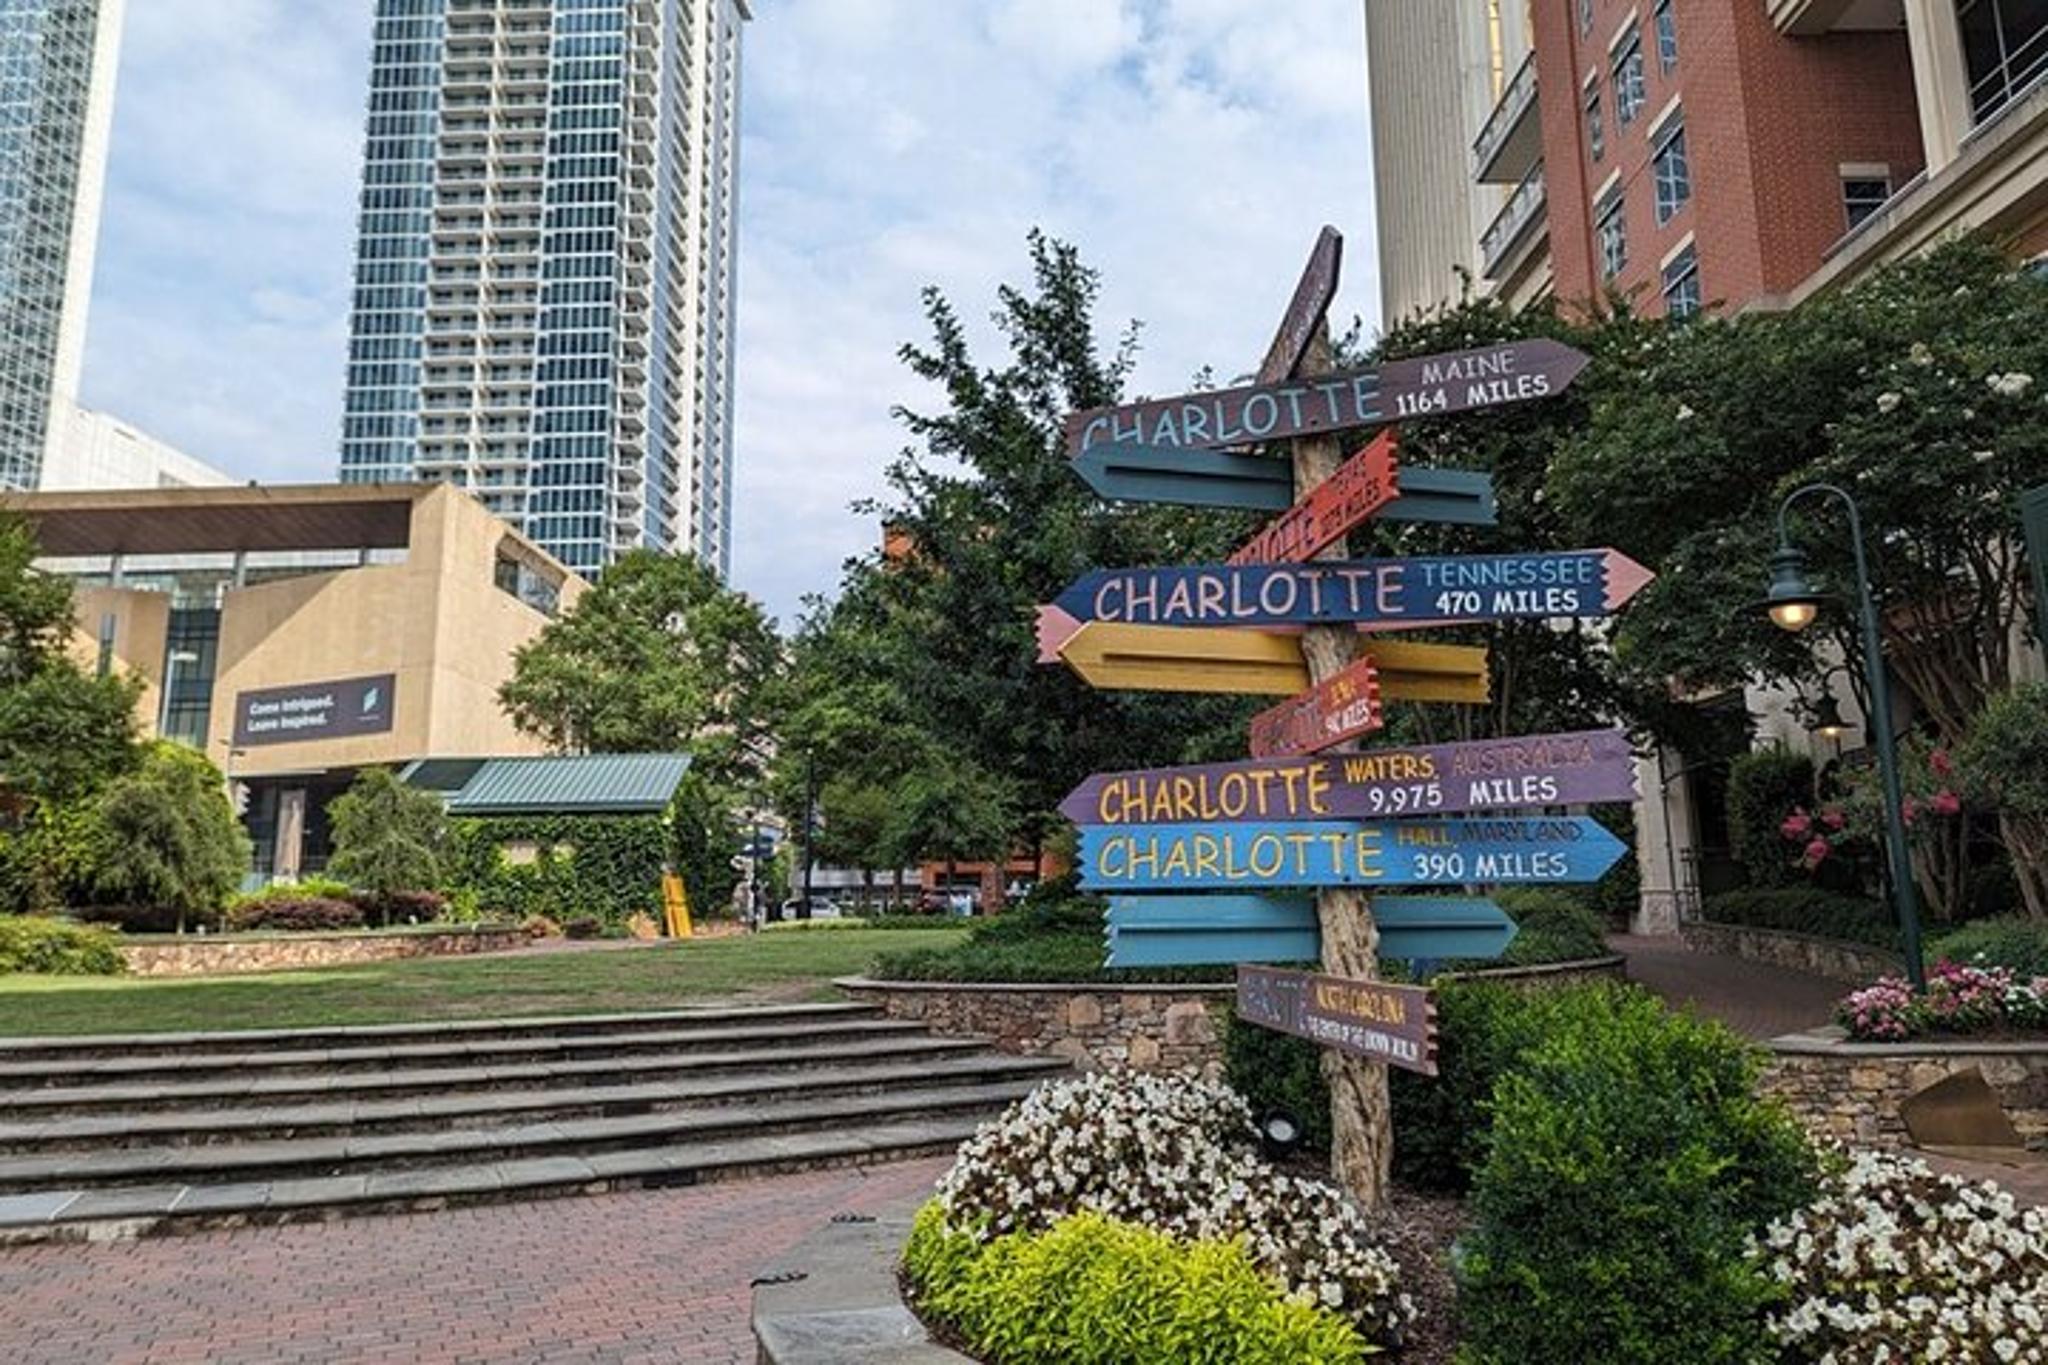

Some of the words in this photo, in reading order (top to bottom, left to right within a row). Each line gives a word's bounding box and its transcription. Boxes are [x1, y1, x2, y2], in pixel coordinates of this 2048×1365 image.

[1421, 349, 1516, 385] MAINE
[1082, 377, 1383, 451] CHARLOTTE
[1395, 387, 1447, 416] 1164
[1467, 374, 1549, 405] MILES
[1094, 565, 1405, 622] CHARLOTTE
[1420, 556, 1593, 588] TENNESSEE
[1434, 590, 1482, 615] 470
[1492, 587, 1581, 614] MILES
[1099, 762, 1332, 824] CHARLOTTE
[1368, 783, 1443, 823] 9,975
[1469, 776, 1558, 806] MILES
[1099, 829, 1384, 881] CHARLOTTE
[1413, 852, 1464, 880] 390
[1474, 852, 1569, 878] MILES
